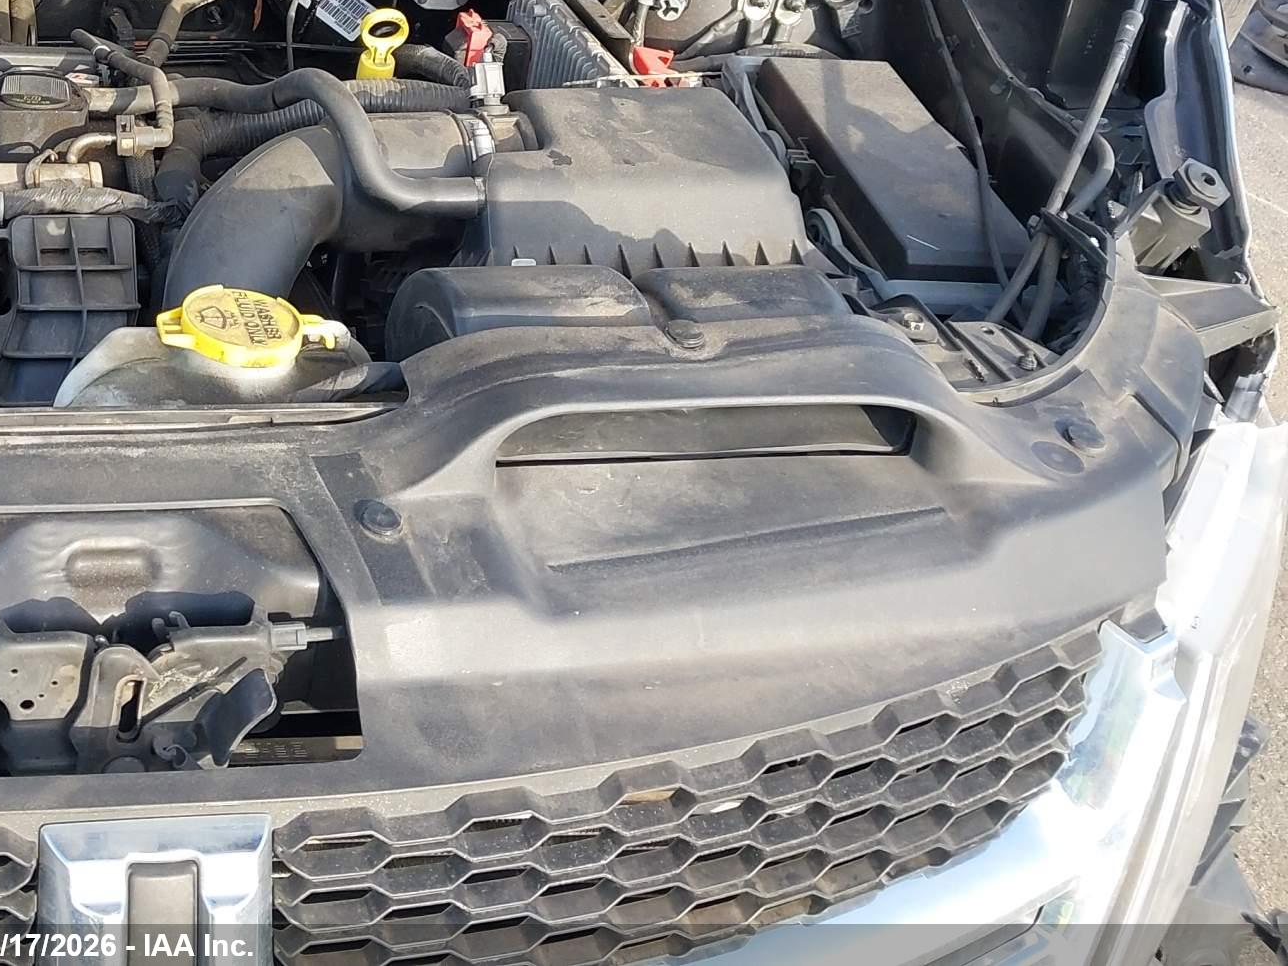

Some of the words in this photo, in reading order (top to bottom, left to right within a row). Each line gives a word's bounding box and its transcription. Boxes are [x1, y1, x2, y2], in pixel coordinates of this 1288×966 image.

[231, 291, 256, 319] FLUID
[244, 320, 268, 346] ONLY
[253, 298, 282, 340] WASHER
